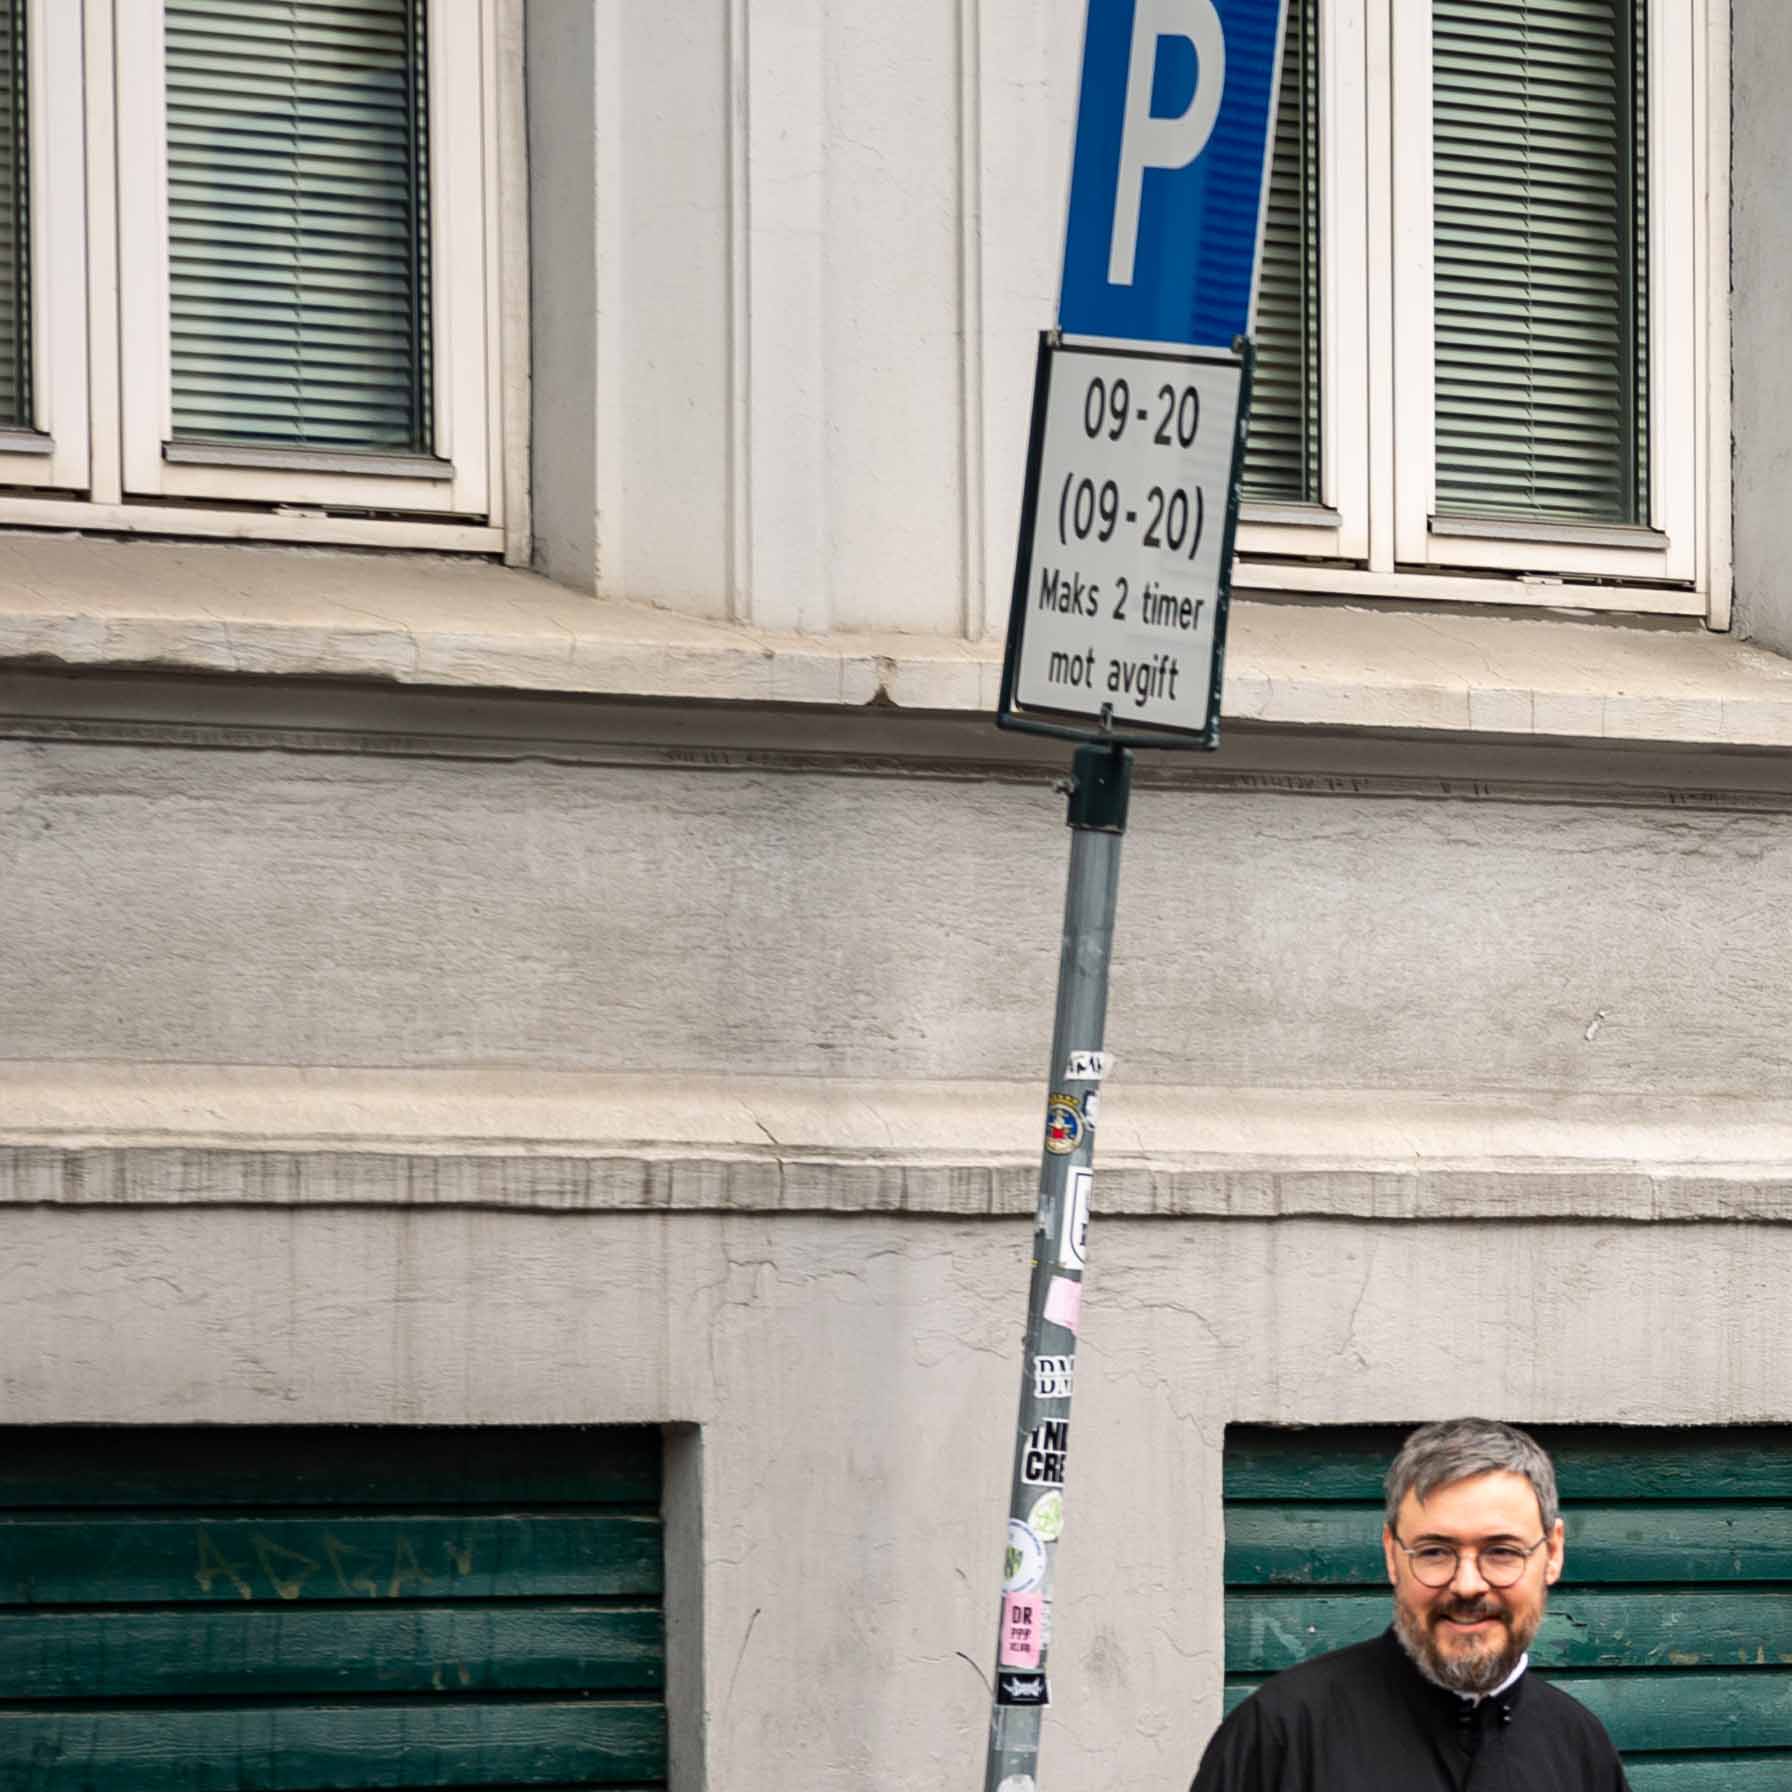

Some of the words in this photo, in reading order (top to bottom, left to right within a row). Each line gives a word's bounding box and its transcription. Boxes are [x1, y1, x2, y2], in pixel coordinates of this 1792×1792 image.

[1107, 0, 1226, 287] P
[1084, 376, 1200, 449] 09-20
[1058, 472, 1204, 561] (09-20)
[1038, 567, 1100, 618] Maks
[1112, 576, 1129, 621] 2
[1141, 581, 1204, 630] timer
[1048, 645, 1096, 689] mot
[1107, 653, 1180, 708] avgift
